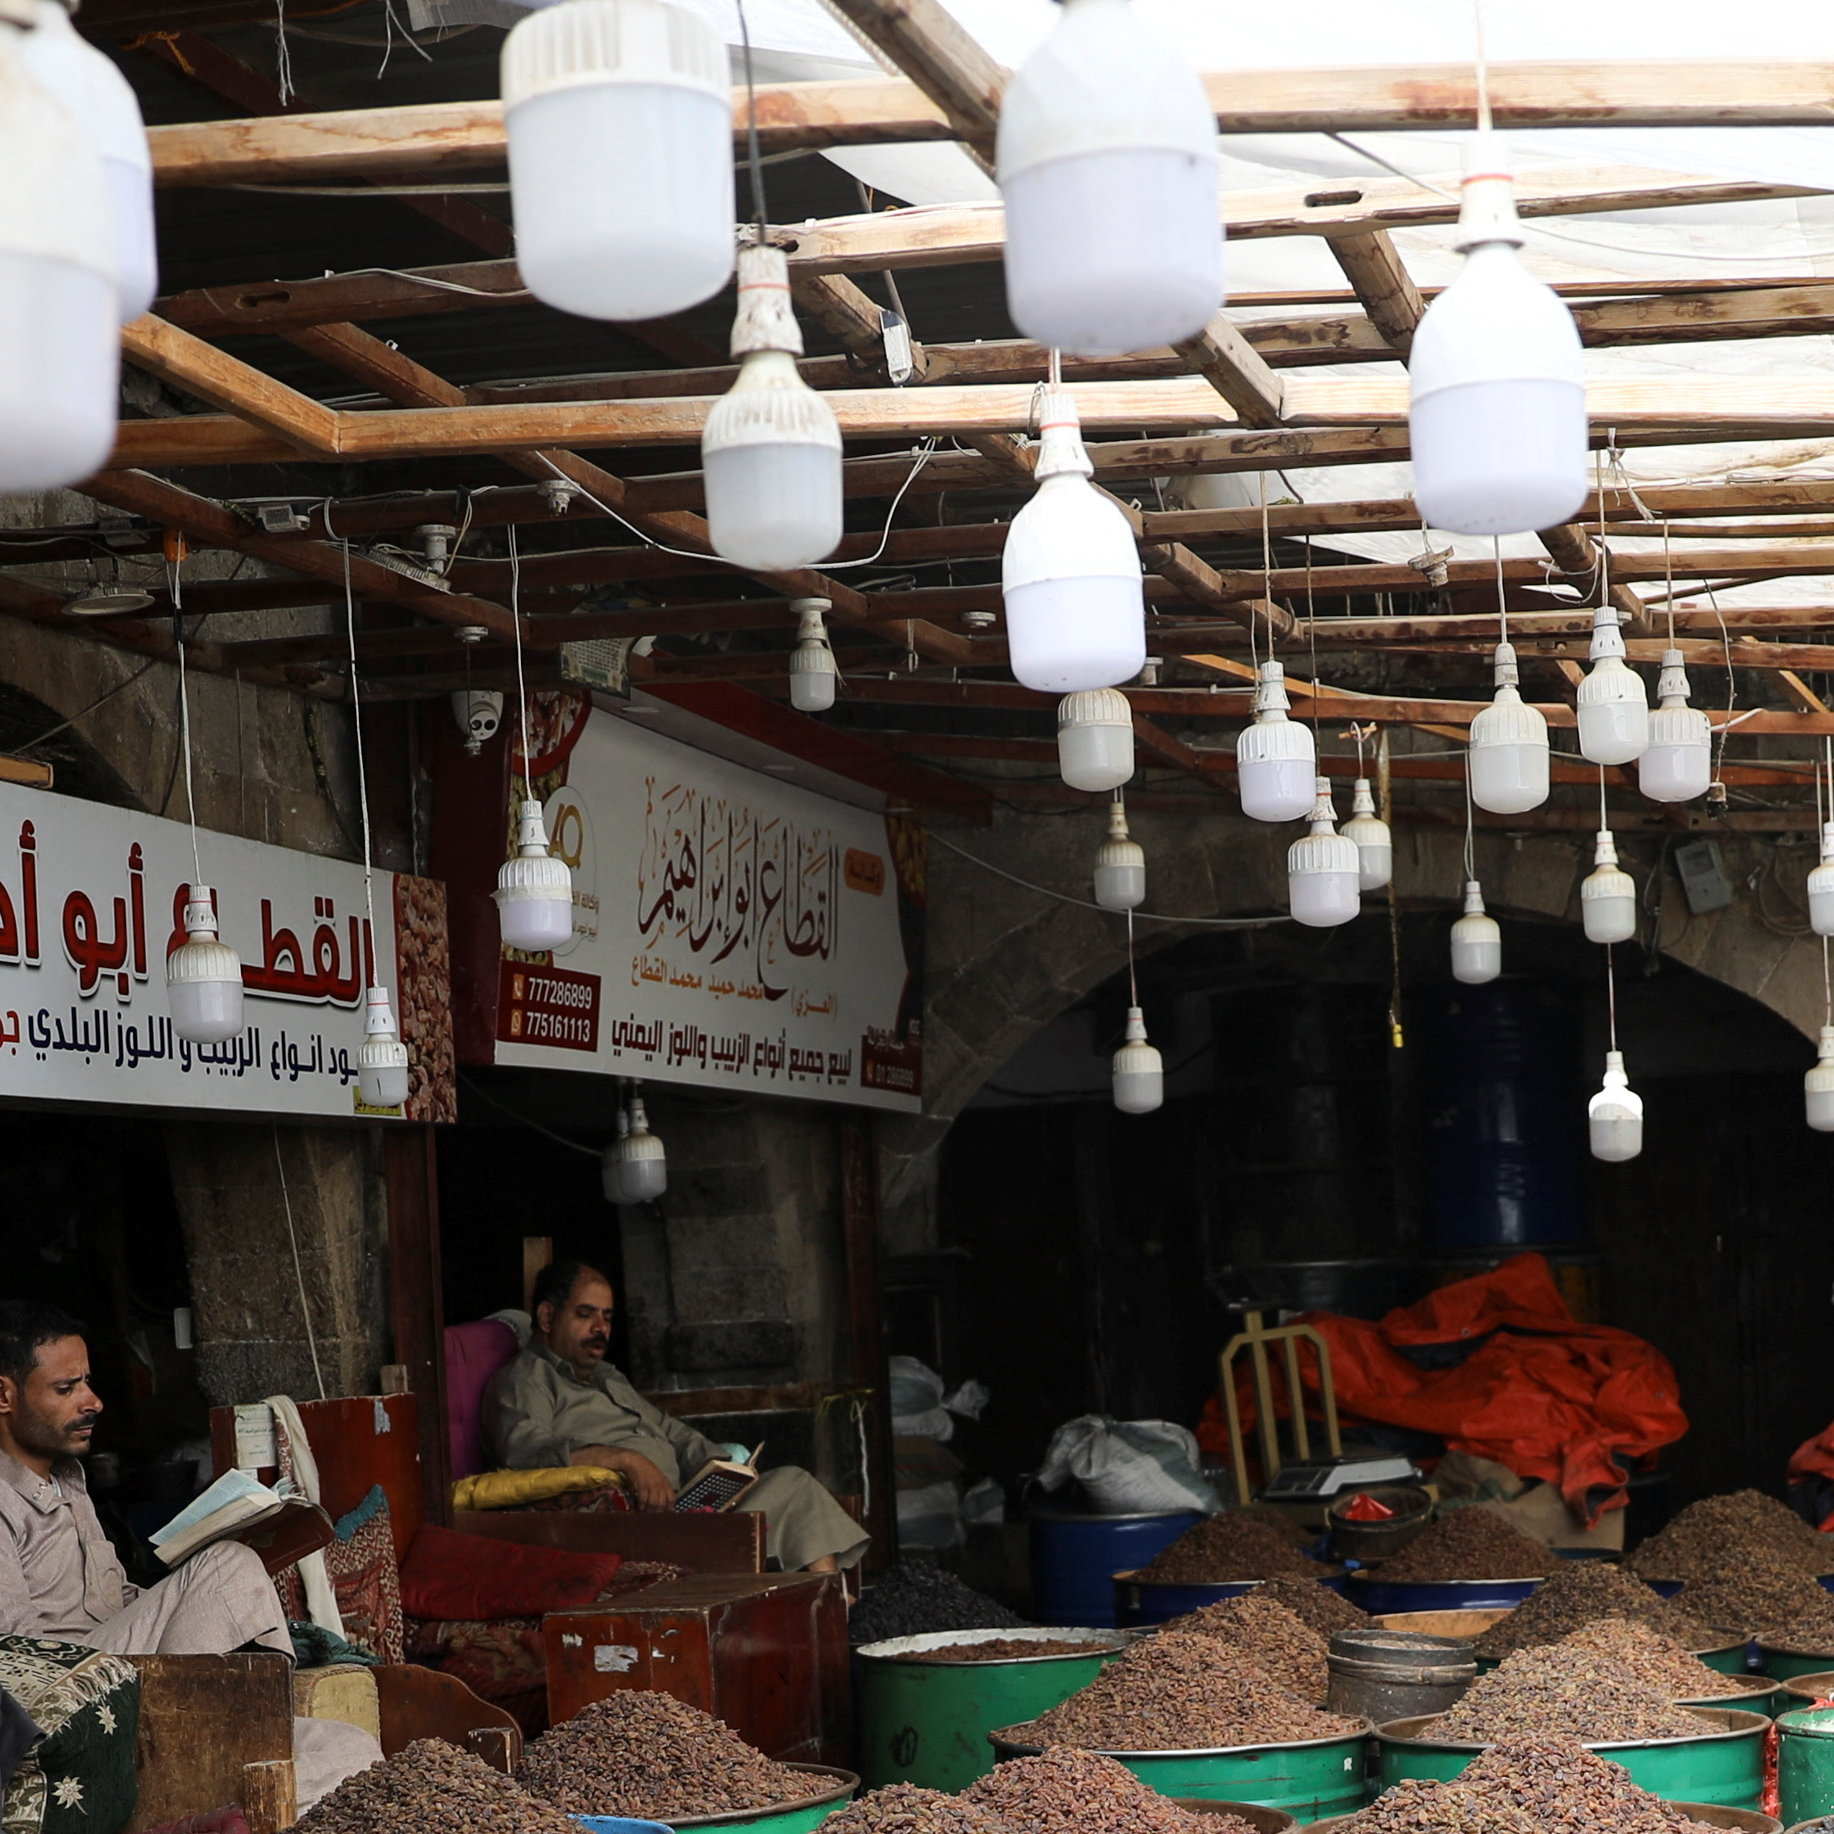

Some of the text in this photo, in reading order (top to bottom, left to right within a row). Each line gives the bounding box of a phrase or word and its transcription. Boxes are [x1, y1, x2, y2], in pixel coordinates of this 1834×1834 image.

[62, 842, 147, 996] أبو
[631, 953, 668, 987] القطاع
[669, 964, 702, 989] محمد
[528, 977, 592, 1010] 777286899
[28, 1006, 110, 1065] البلدي
[526, 1011, 591, 1043] 775161113
[612, 1013, 851, 1085] لبيع جميع أنواع الزبيب واللوز اليمني
